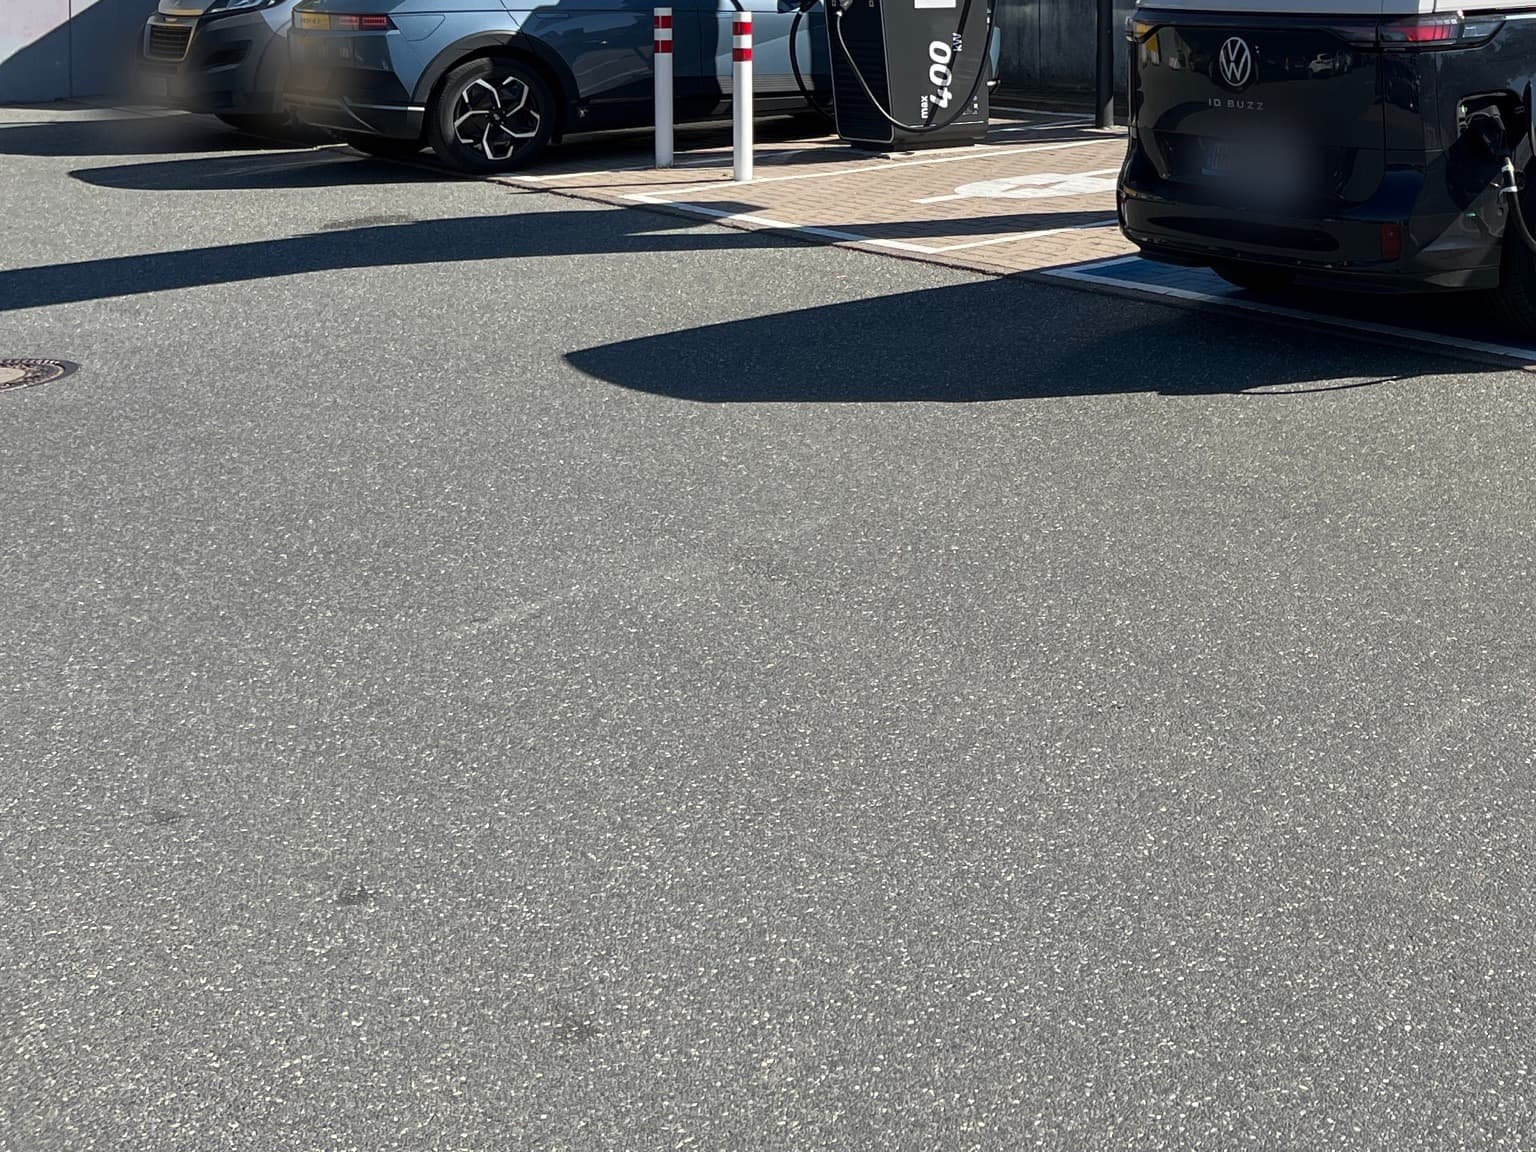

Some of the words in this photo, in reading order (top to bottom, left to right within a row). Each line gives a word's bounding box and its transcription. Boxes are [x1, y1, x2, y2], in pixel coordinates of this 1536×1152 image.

[921, 95, 929, 119] max
[929, 41, 953, 108] 400
[952, 32, 963, 52] kW
[1227, 99, 1264, 111] BUZZ
